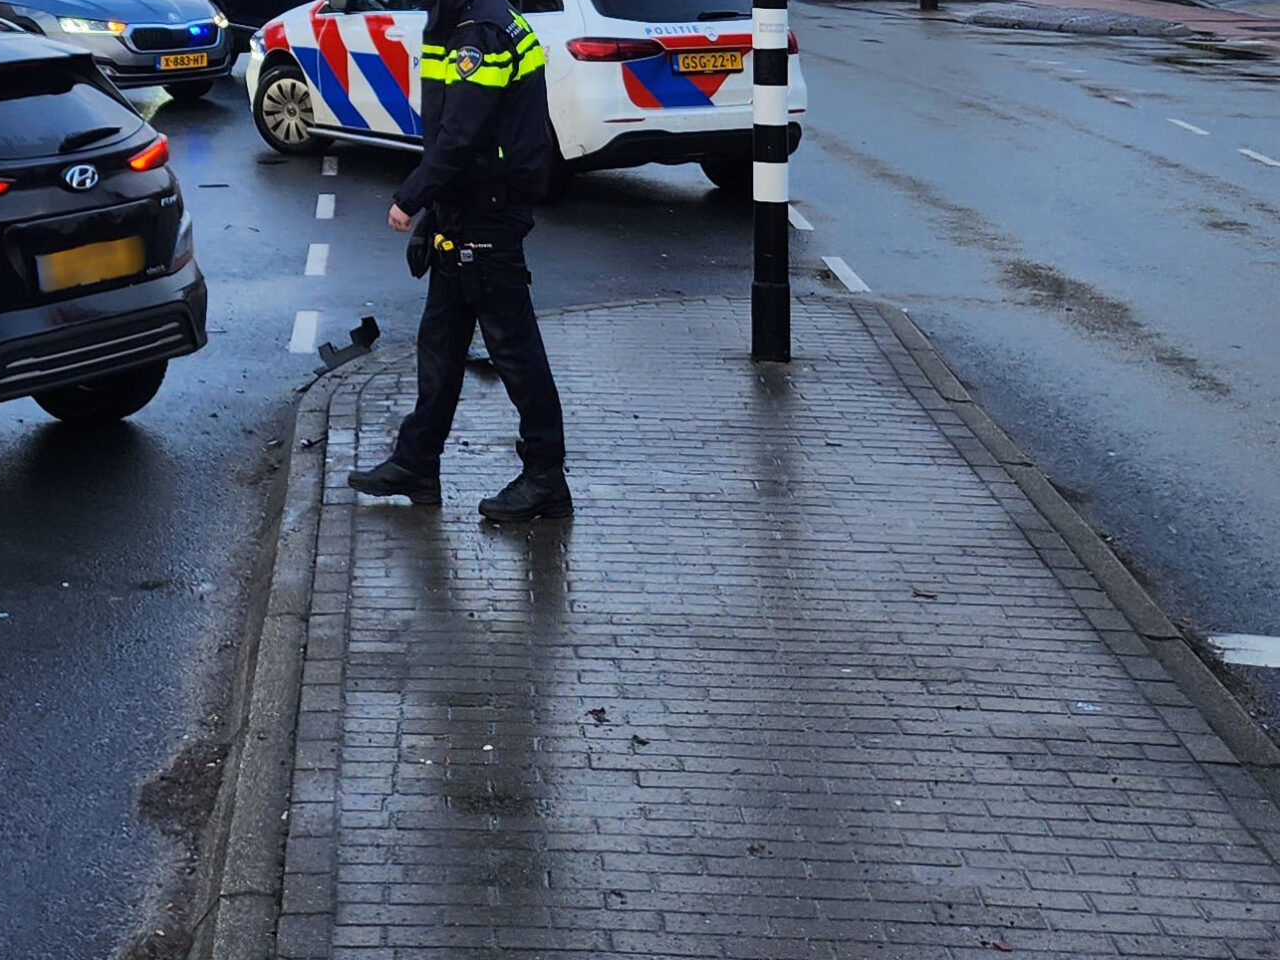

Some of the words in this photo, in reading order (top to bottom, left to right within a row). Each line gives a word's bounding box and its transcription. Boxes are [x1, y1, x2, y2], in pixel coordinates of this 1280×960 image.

[644, 25, 700, 36] POLITIE
[164, 55, 204, 67] X-883-HT
[682, 54, 737, 69] GSG-22-P
